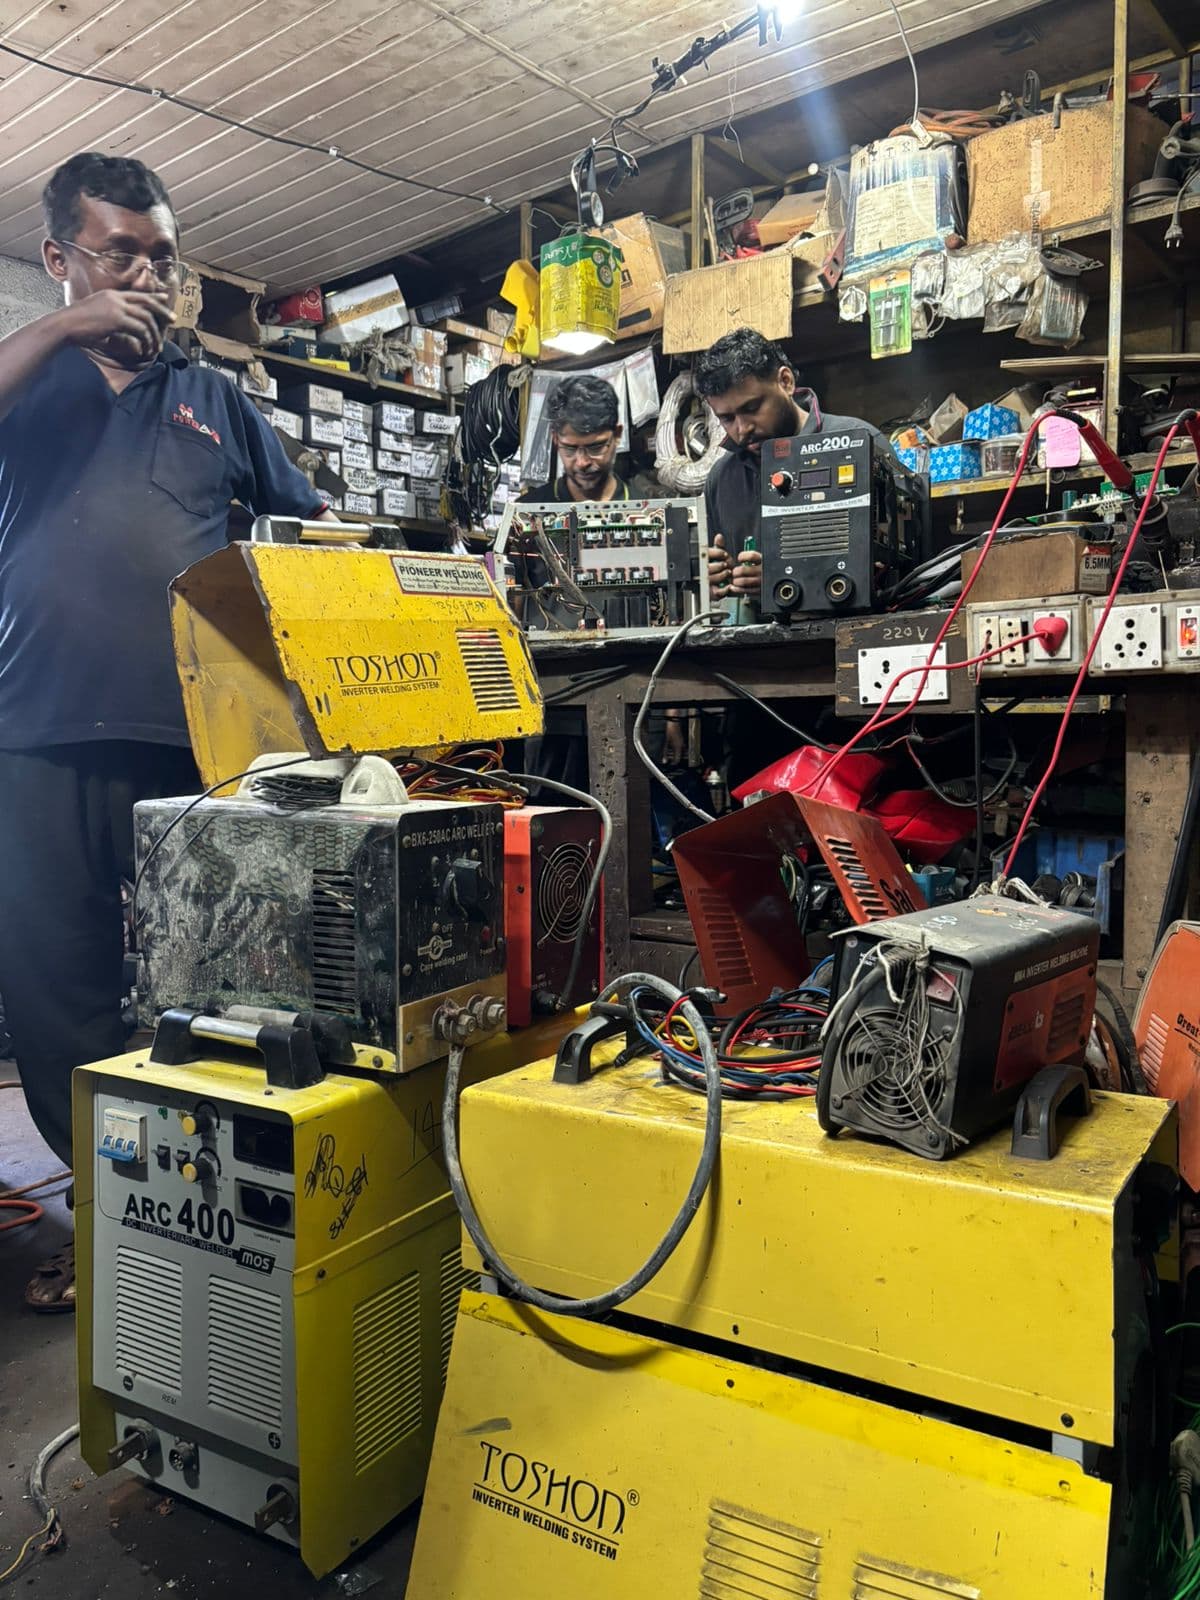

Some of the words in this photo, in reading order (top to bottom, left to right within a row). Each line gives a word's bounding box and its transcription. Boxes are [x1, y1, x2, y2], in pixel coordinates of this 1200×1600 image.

[780, 504, 815, 513] INVERTER
[400, 565, 442, 578] PIONEER
[443, 568, 485, 580] WELDING
[883, 626, 913, 640] 220
[917, 625, 929, 641] V
[341, 685, 380, 697] INVERTER
[380, 683, 412, 694] WELDING
[413, 681, 439, 691] SYSTEM
[451, 825, 466, 840] ARC
[1050, 952, 1070, 969] WELDING
[1070, 945, 1089, 961] MACHINE
[125, 1193, 172, 1227] ARC
[177, 1198, 235, 1246] 400
[200, 1241, 235, 1258] WELDER
[472, 1488, 521, 1518] INVERTER
[523, 1509, 569, 1540] WELDING
[571, 1531, 618, 1561] SYSTEM
